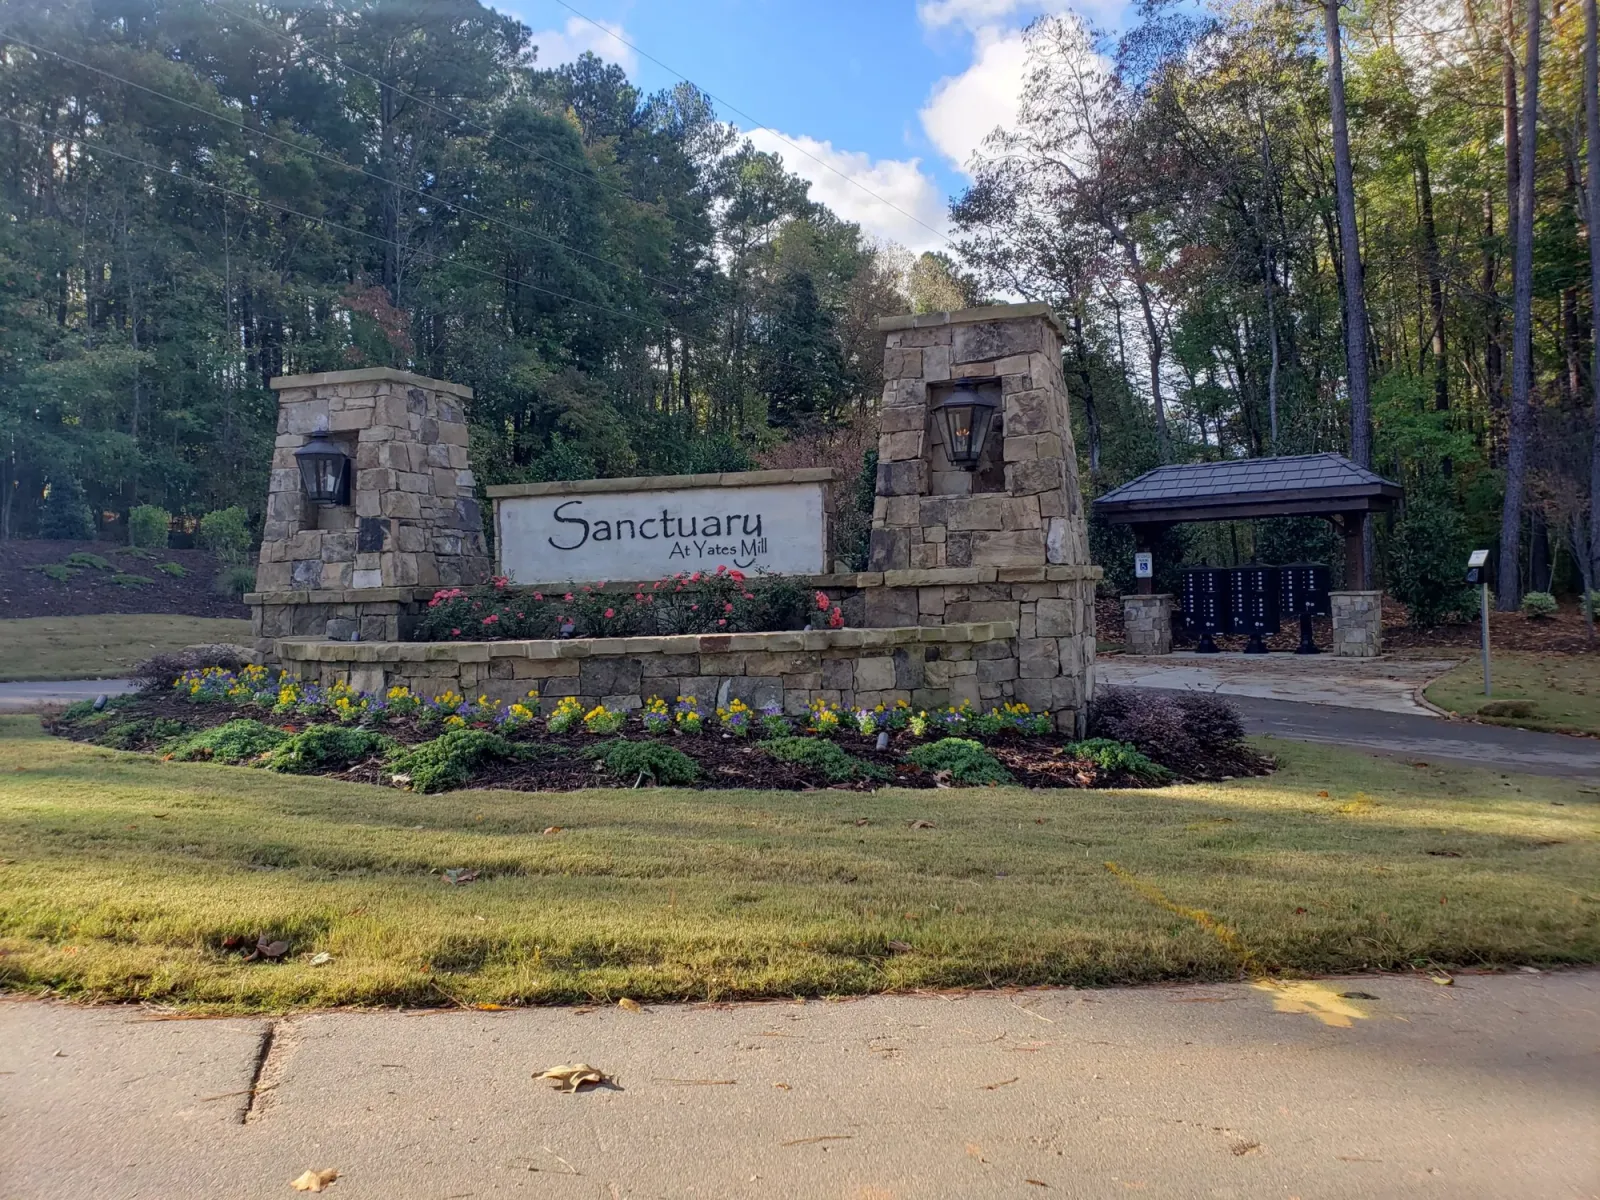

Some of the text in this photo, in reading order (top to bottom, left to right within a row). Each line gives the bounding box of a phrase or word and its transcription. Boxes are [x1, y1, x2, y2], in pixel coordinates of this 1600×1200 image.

[548, 500, 762, 567] Sanctuary
[668, 537, 768, 559] At Yates Mill
